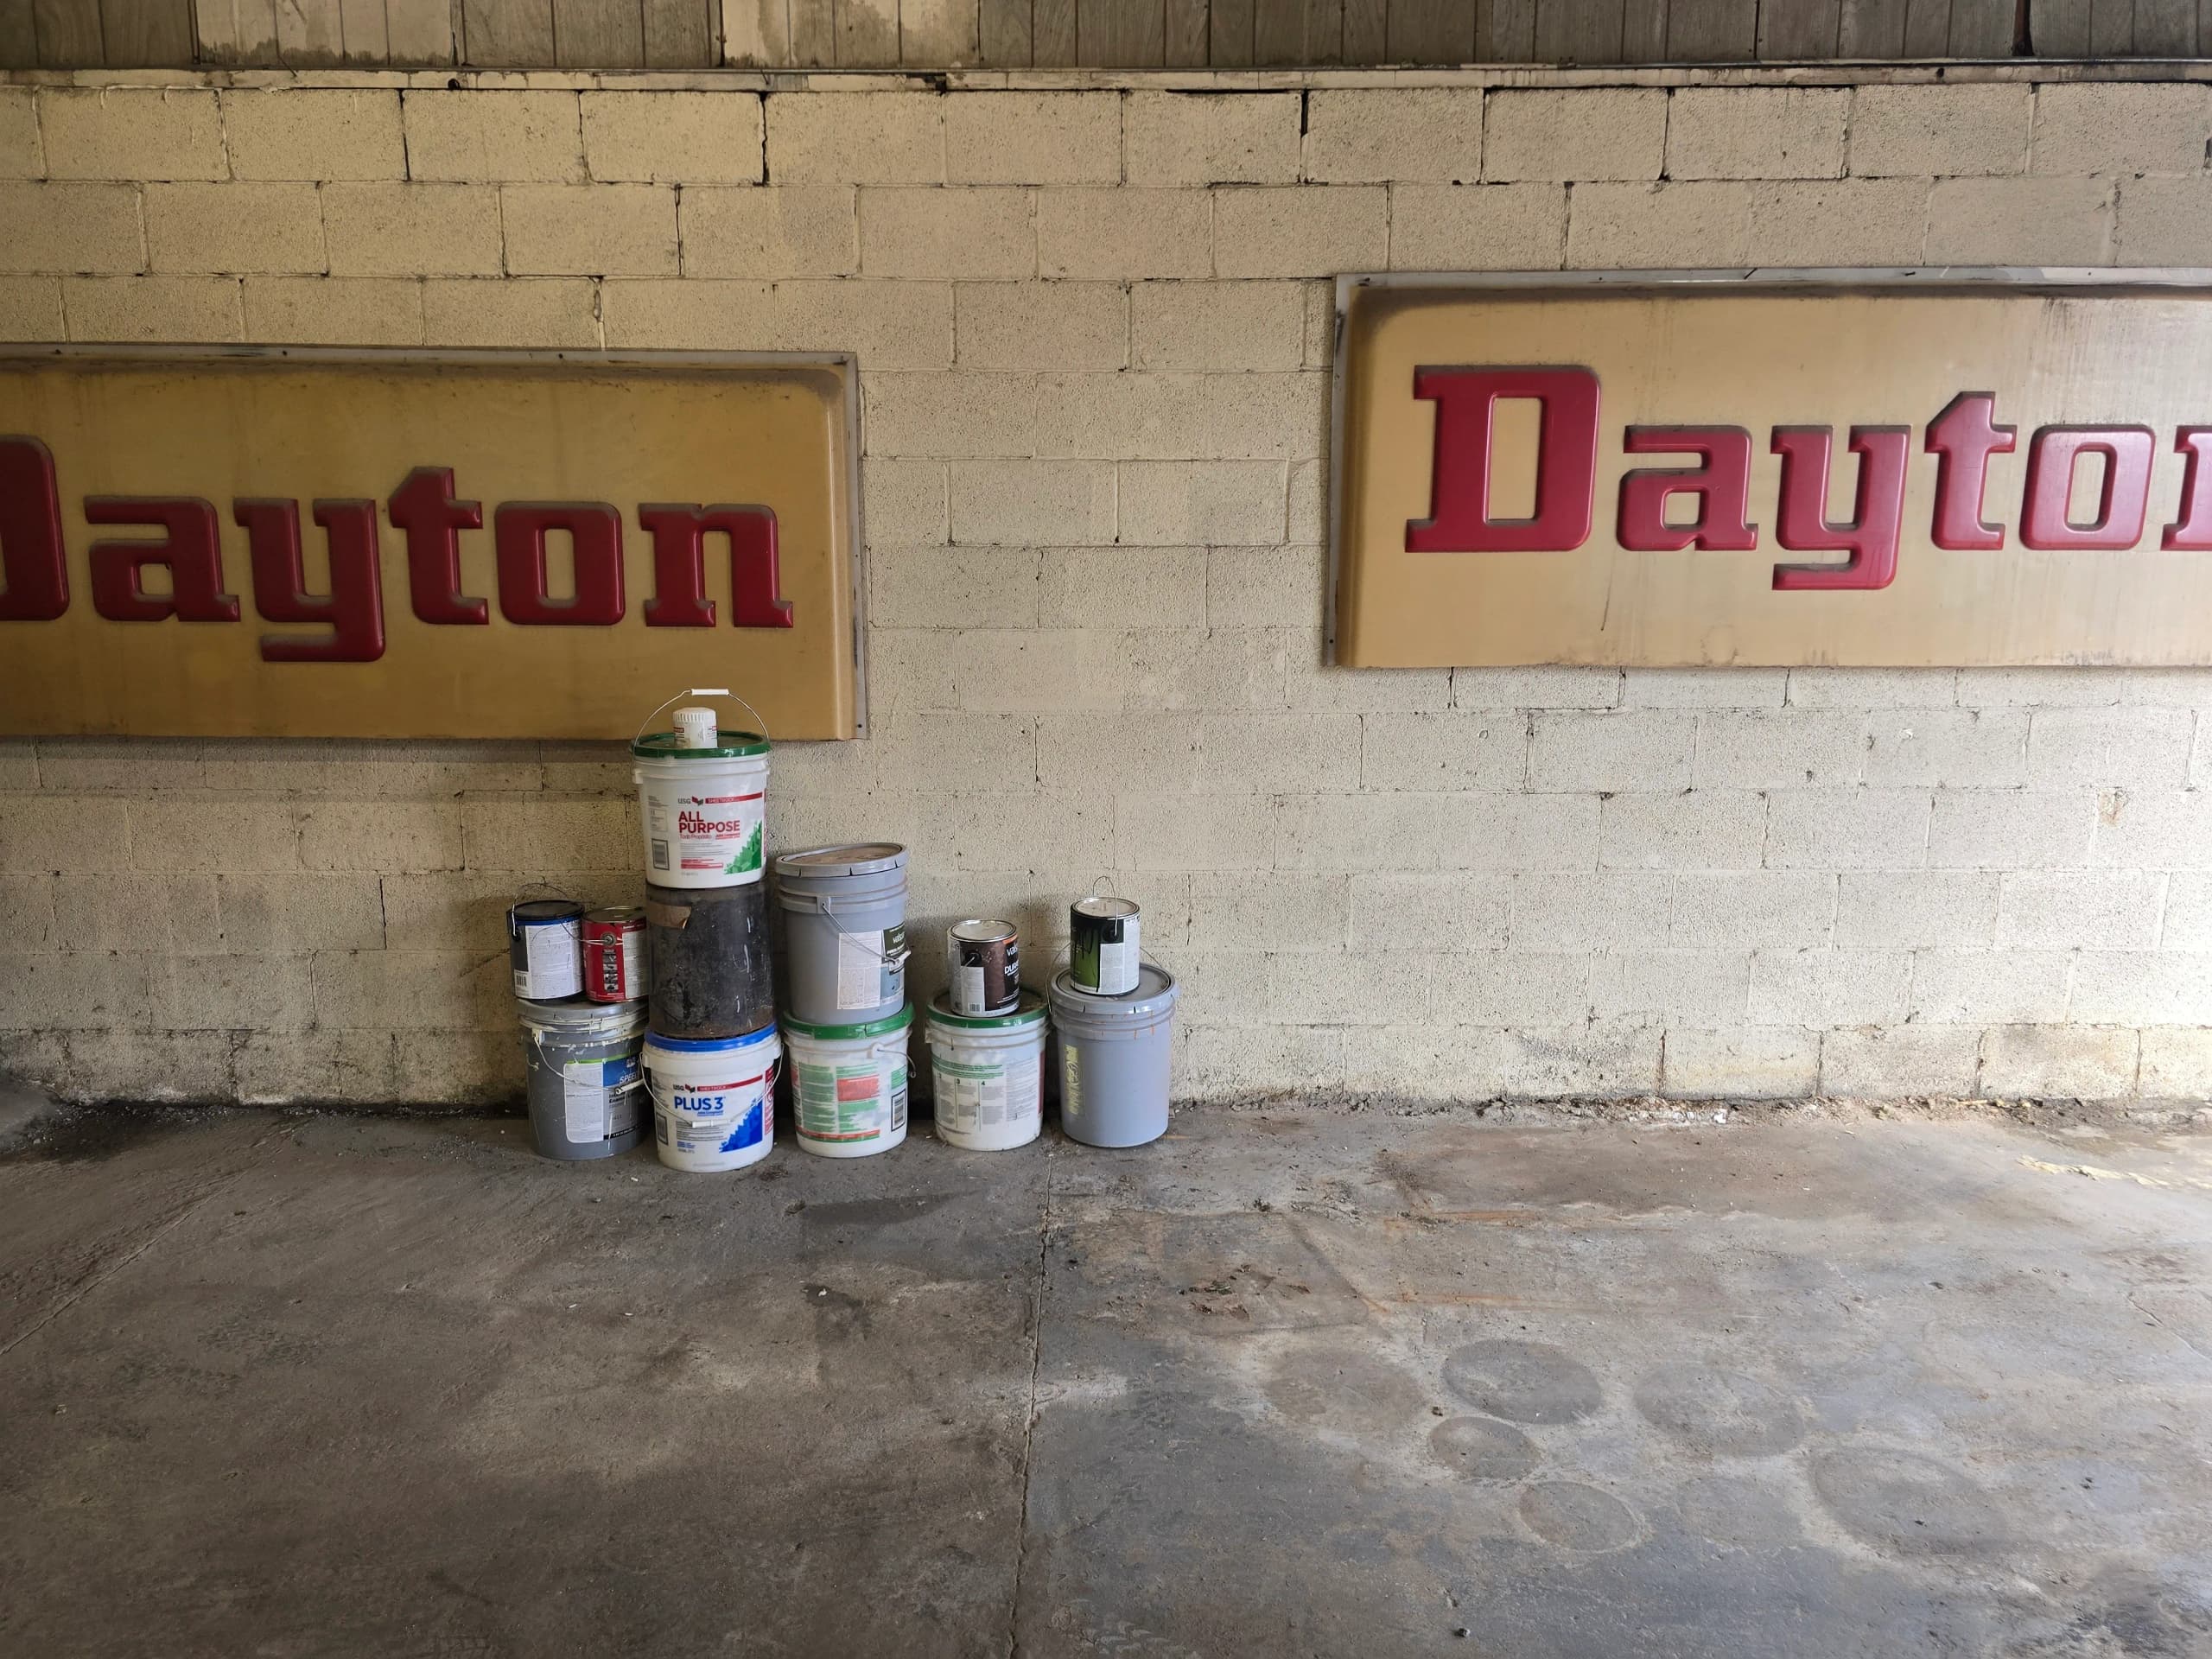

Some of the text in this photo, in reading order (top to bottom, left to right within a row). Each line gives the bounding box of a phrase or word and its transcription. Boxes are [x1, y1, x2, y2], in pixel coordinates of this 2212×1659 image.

[678, 810, 704, 823] ALL
[679, 820, 741, 834] PURPOSE
[674, 1096, 724, 1111] PLUS 3
